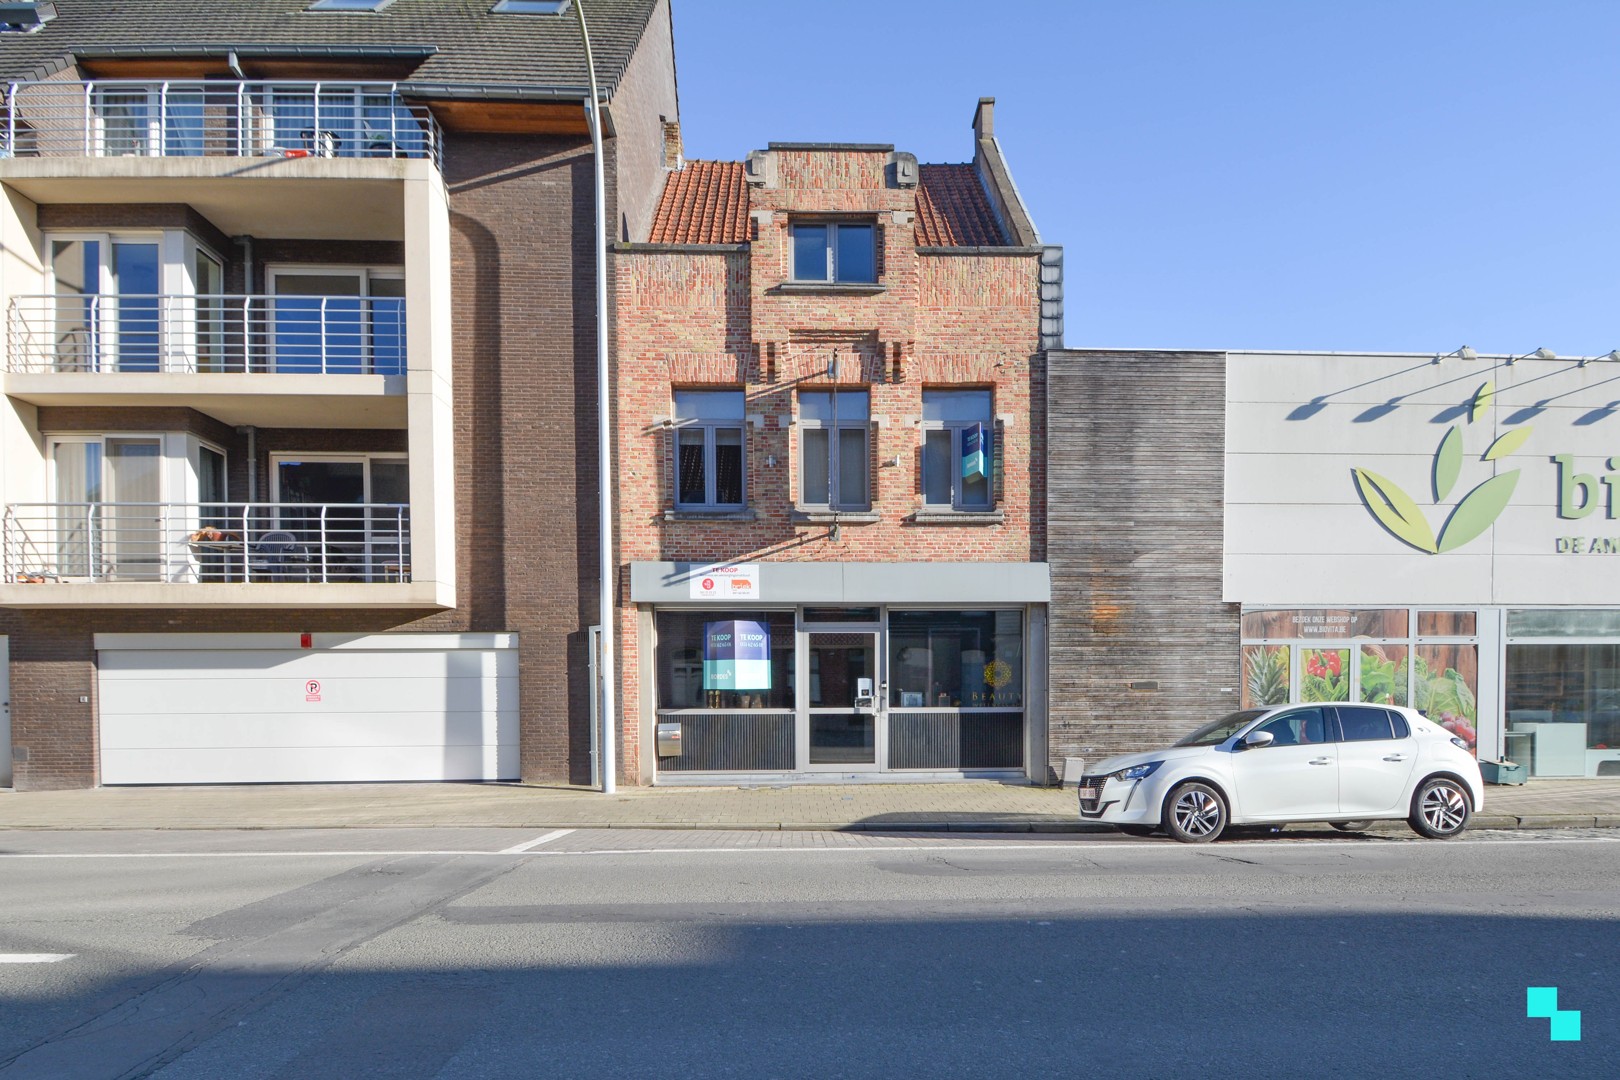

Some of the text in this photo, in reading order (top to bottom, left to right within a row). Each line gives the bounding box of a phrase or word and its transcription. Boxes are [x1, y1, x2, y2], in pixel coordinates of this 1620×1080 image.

[1557, 535, 1585, 554] DE
[1292, 615, 1312, 623] BEZOEK
[1312, 615, 1325, 623] ONZE
[1303, 625, 1347, 633] WWW.BIOVITA.BE
[717, 633, 732, 641] KOOP
[740, 633, 763, 641] TE KOOP
[972, 691, 1022, 701] BEAUTY
